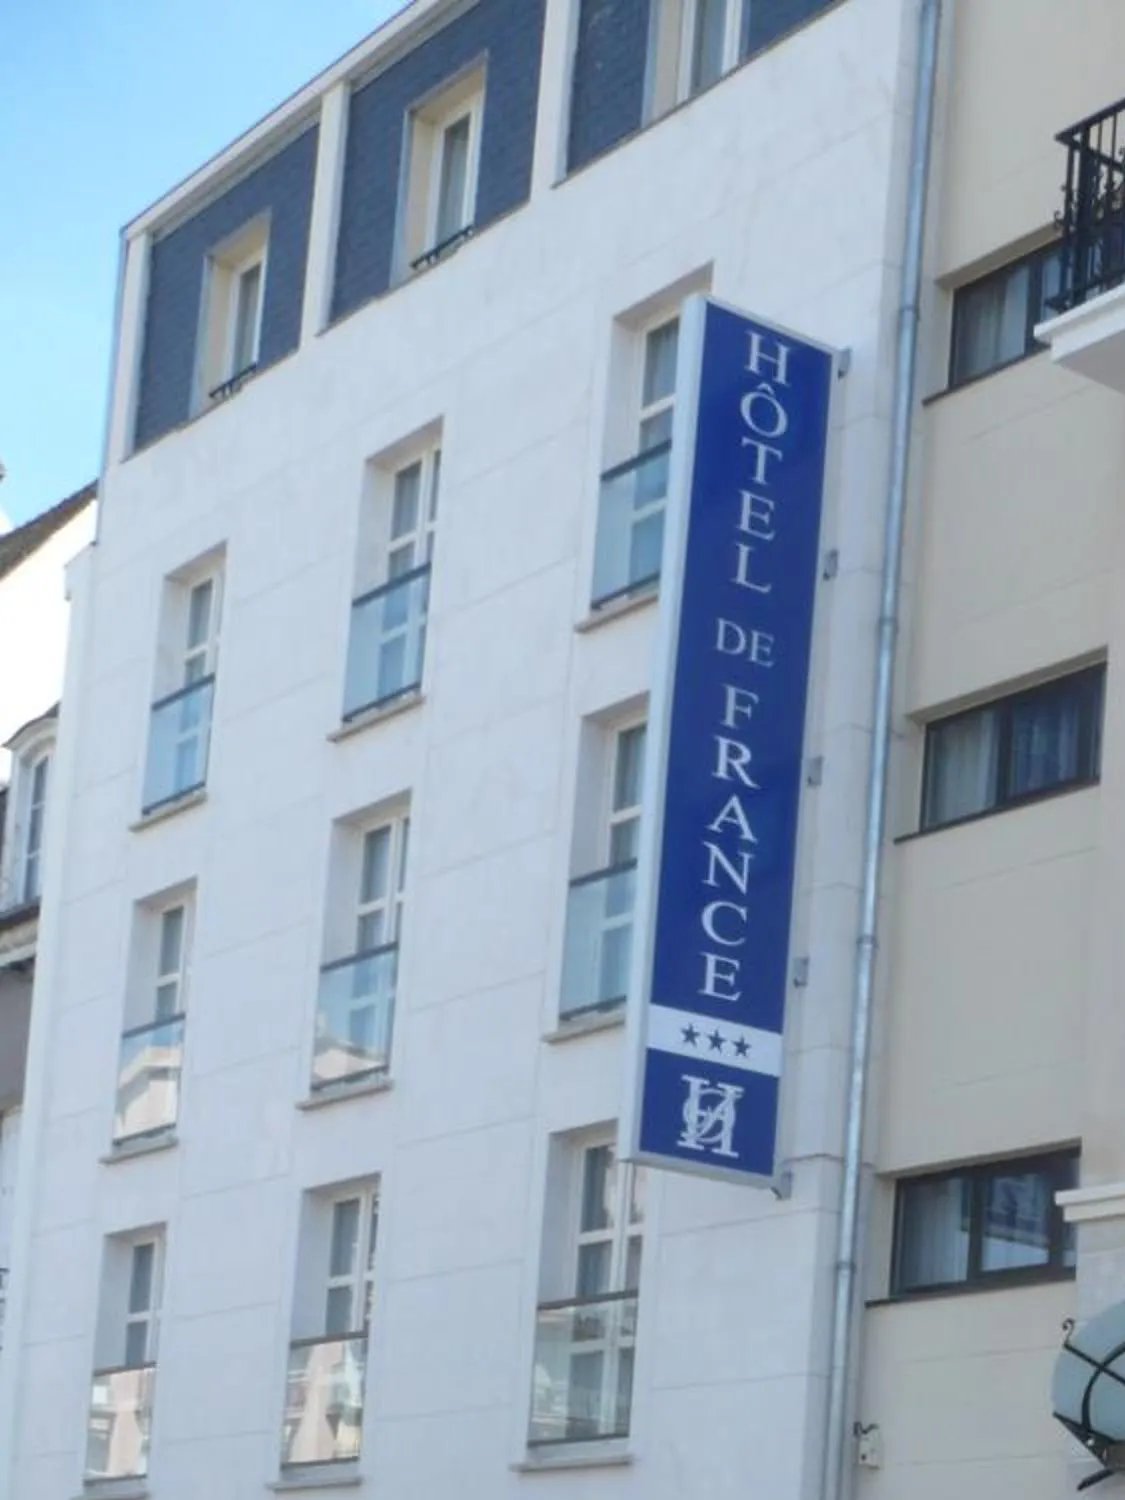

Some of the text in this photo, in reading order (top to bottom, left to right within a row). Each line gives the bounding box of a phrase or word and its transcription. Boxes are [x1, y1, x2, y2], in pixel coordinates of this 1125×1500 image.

[730, 330, 791, 594] HÔTEL
[715, 617, 775, 668] DE
[698, 682, 761, 1002] FRANCE
